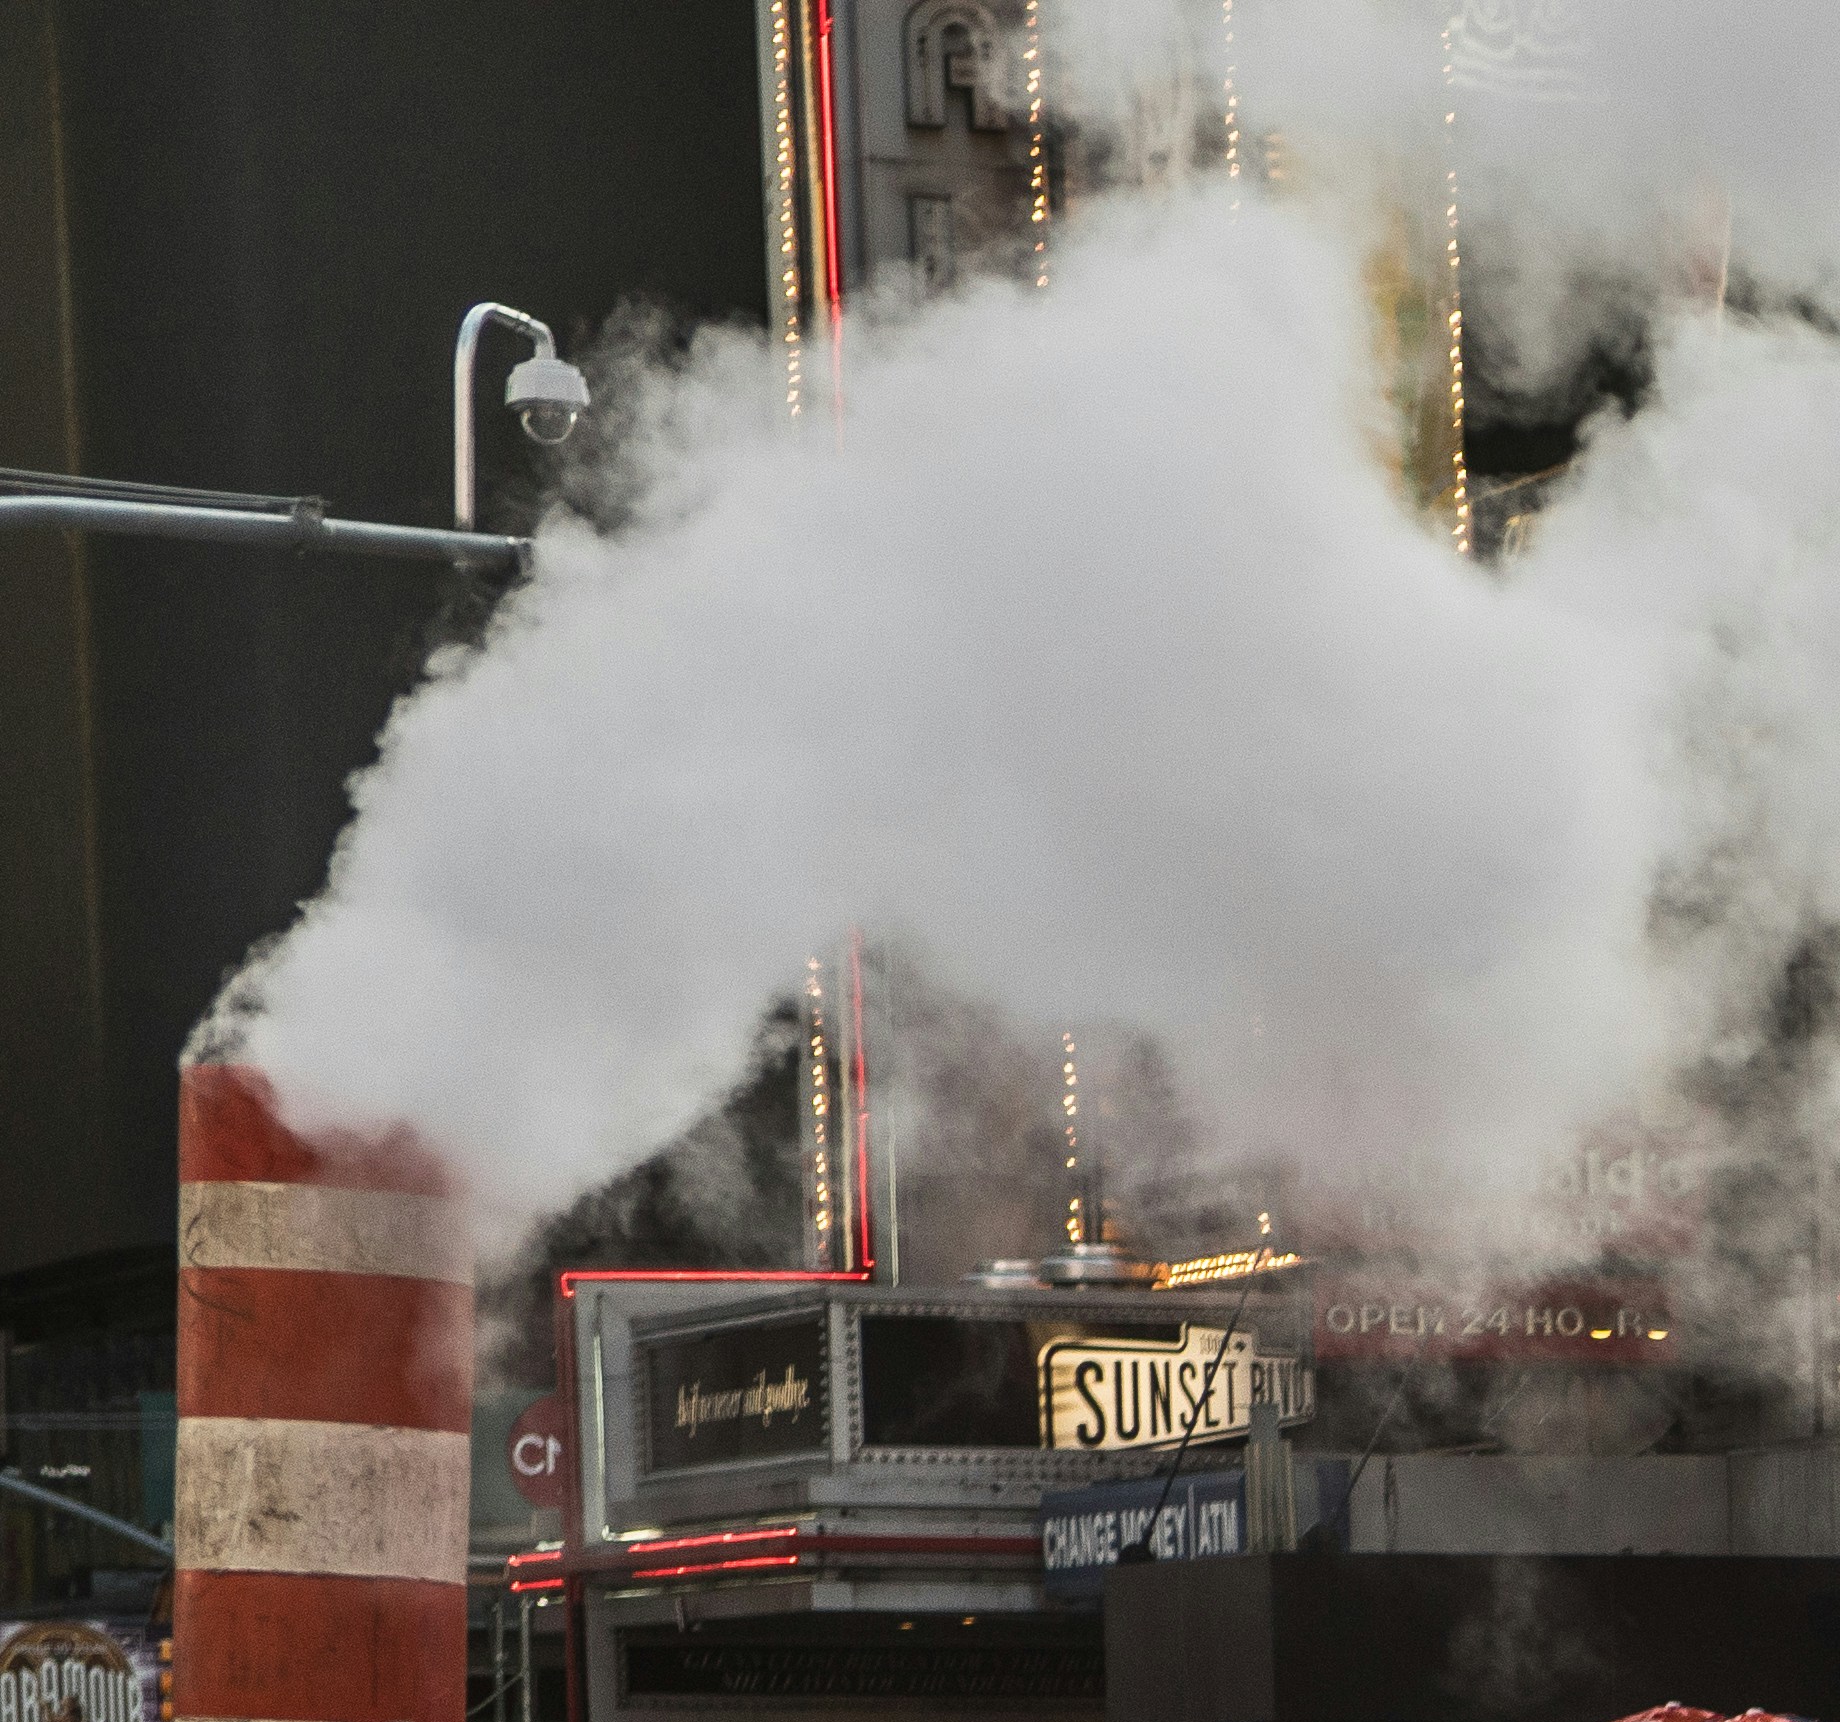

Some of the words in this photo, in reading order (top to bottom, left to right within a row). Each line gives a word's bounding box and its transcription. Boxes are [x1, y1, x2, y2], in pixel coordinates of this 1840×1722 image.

[1461, 1304, 1510, 1337] 24
[1524, 1304, 1668, 1340] HOR
[1075, 1360, 1235, 1446] SUNSET
[1043, 1513, 1119, 1570] CHANGE
[1198, 1499, 1239, 1556] ATM
